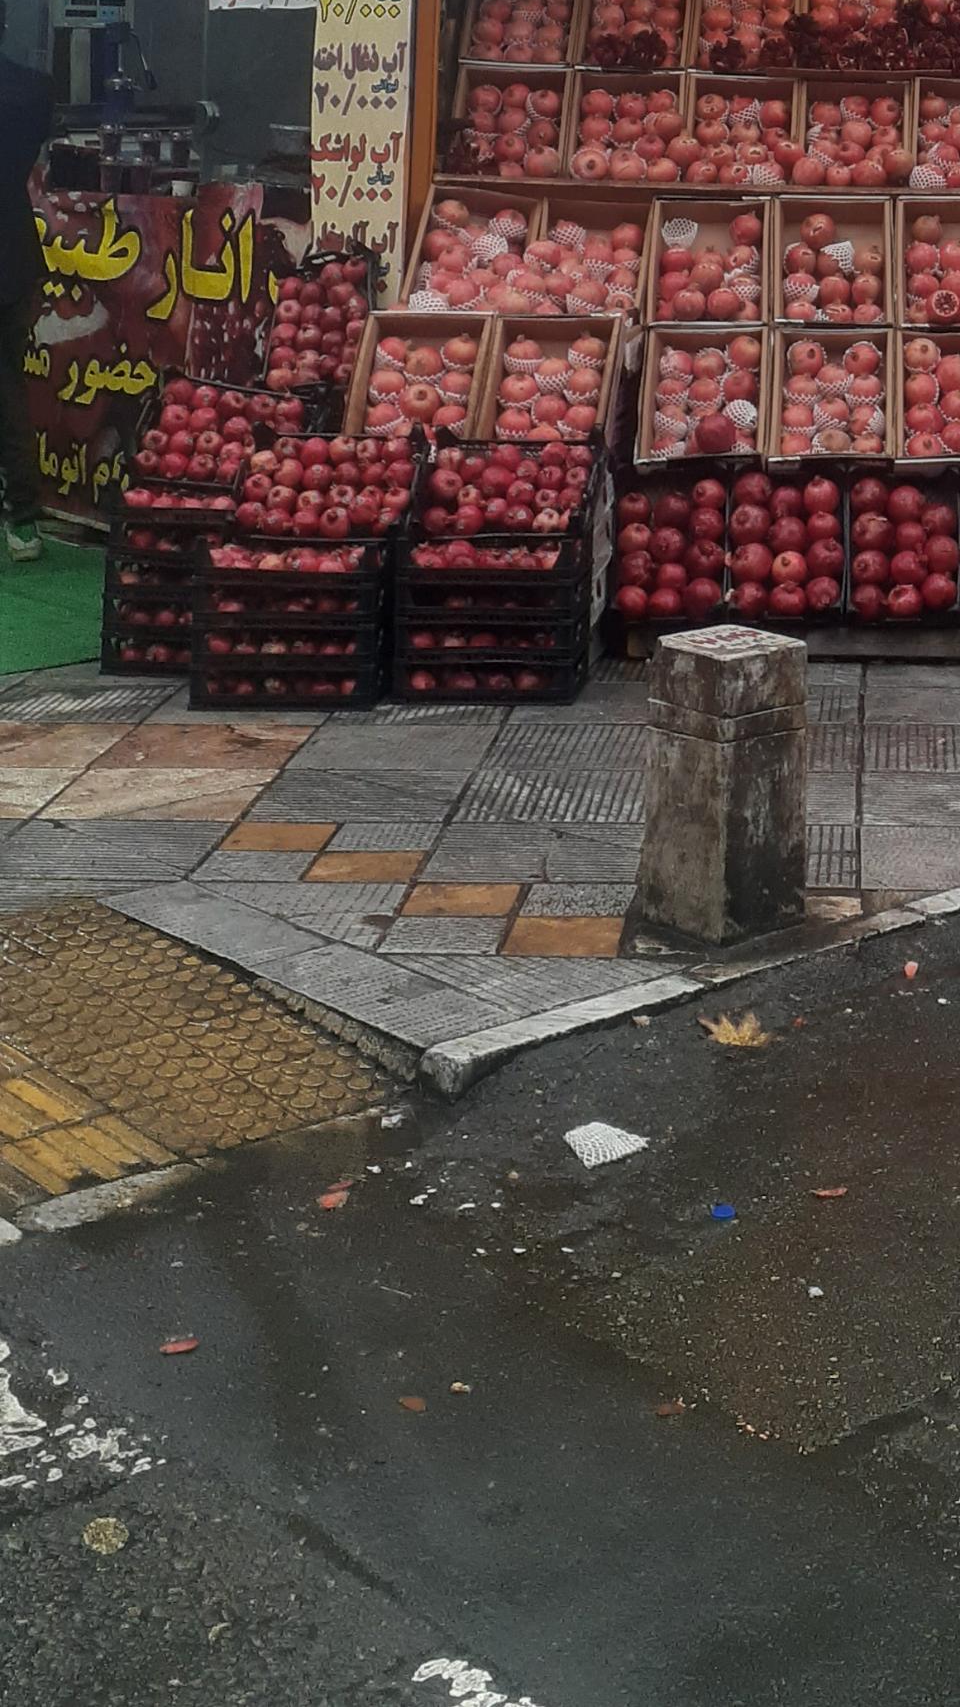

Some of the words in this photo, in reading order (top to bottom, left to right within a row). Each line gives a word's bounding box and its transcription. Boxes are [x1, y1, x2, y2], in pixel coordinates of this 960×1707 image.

[382, 41, 408, 80] آب
[370, 131, 403, 170] آب
[146, 208, 254, 320] انار
[56, 342, 158, 406] حضور
